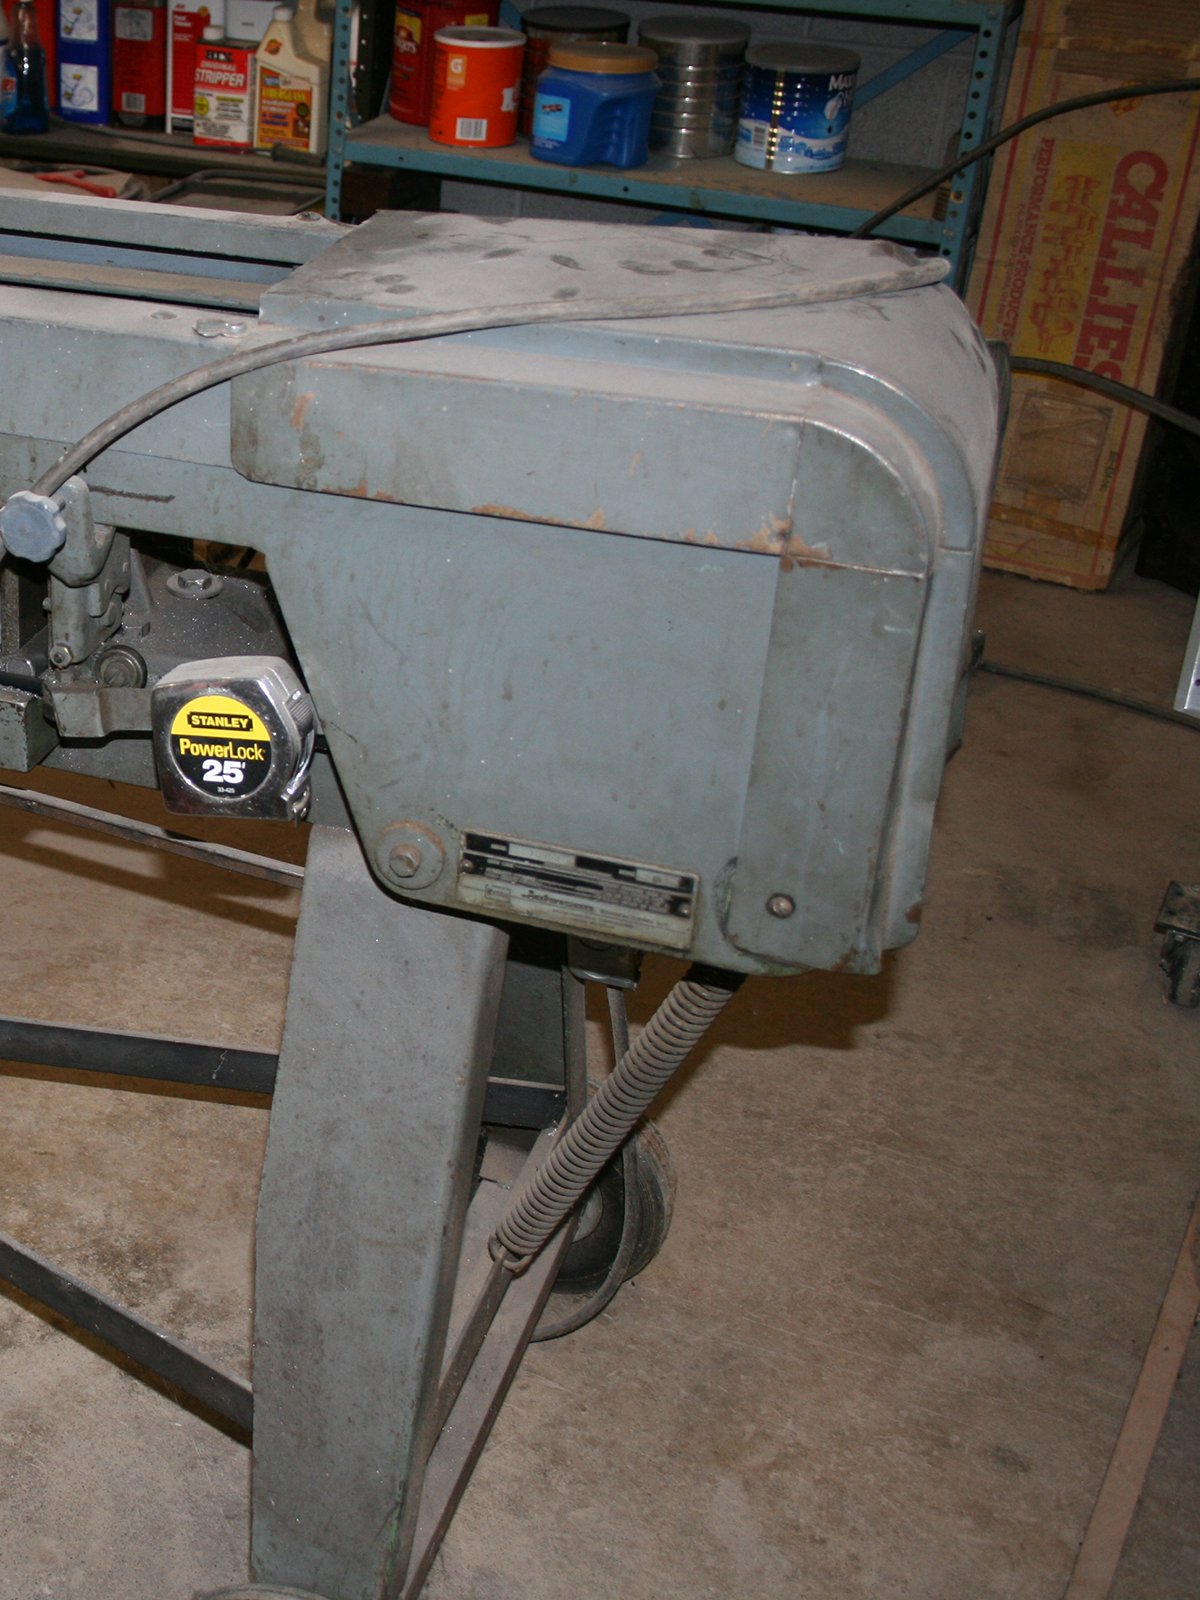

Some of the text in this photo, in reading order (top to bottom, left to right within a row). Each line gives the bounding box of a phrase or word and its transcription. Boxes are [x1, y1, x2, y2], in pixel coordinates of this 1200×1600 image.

[450, 58, 463, 74] G
[194, 68, 245, 87] STRIPPER
[1018, 136, 1057, 257] PERFORMANCE
[190, 715, 249, 729] STANLEY
[179, 738, 265, 761] PowerLock
